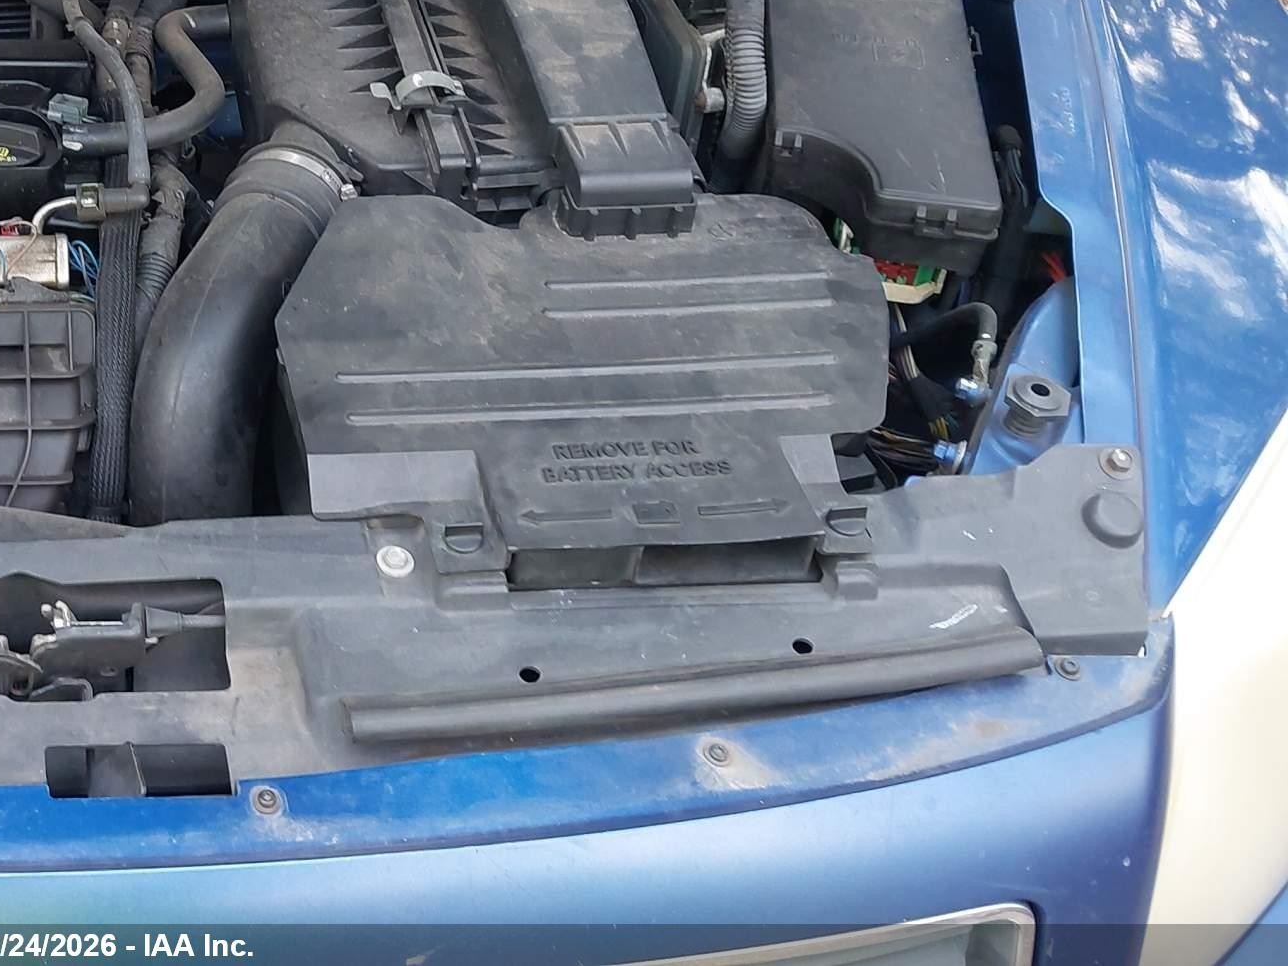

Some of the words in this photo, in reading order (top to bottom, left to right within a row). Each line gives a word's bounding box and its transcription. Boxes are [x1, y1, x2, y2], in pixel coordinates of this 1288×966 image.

[551, 440, 649, 460] REMOVE
[651, 440, 699, 456] FOR
[541, 463, 637, 484] BATTERY
[646, 460, 732, 478] ACCESS
